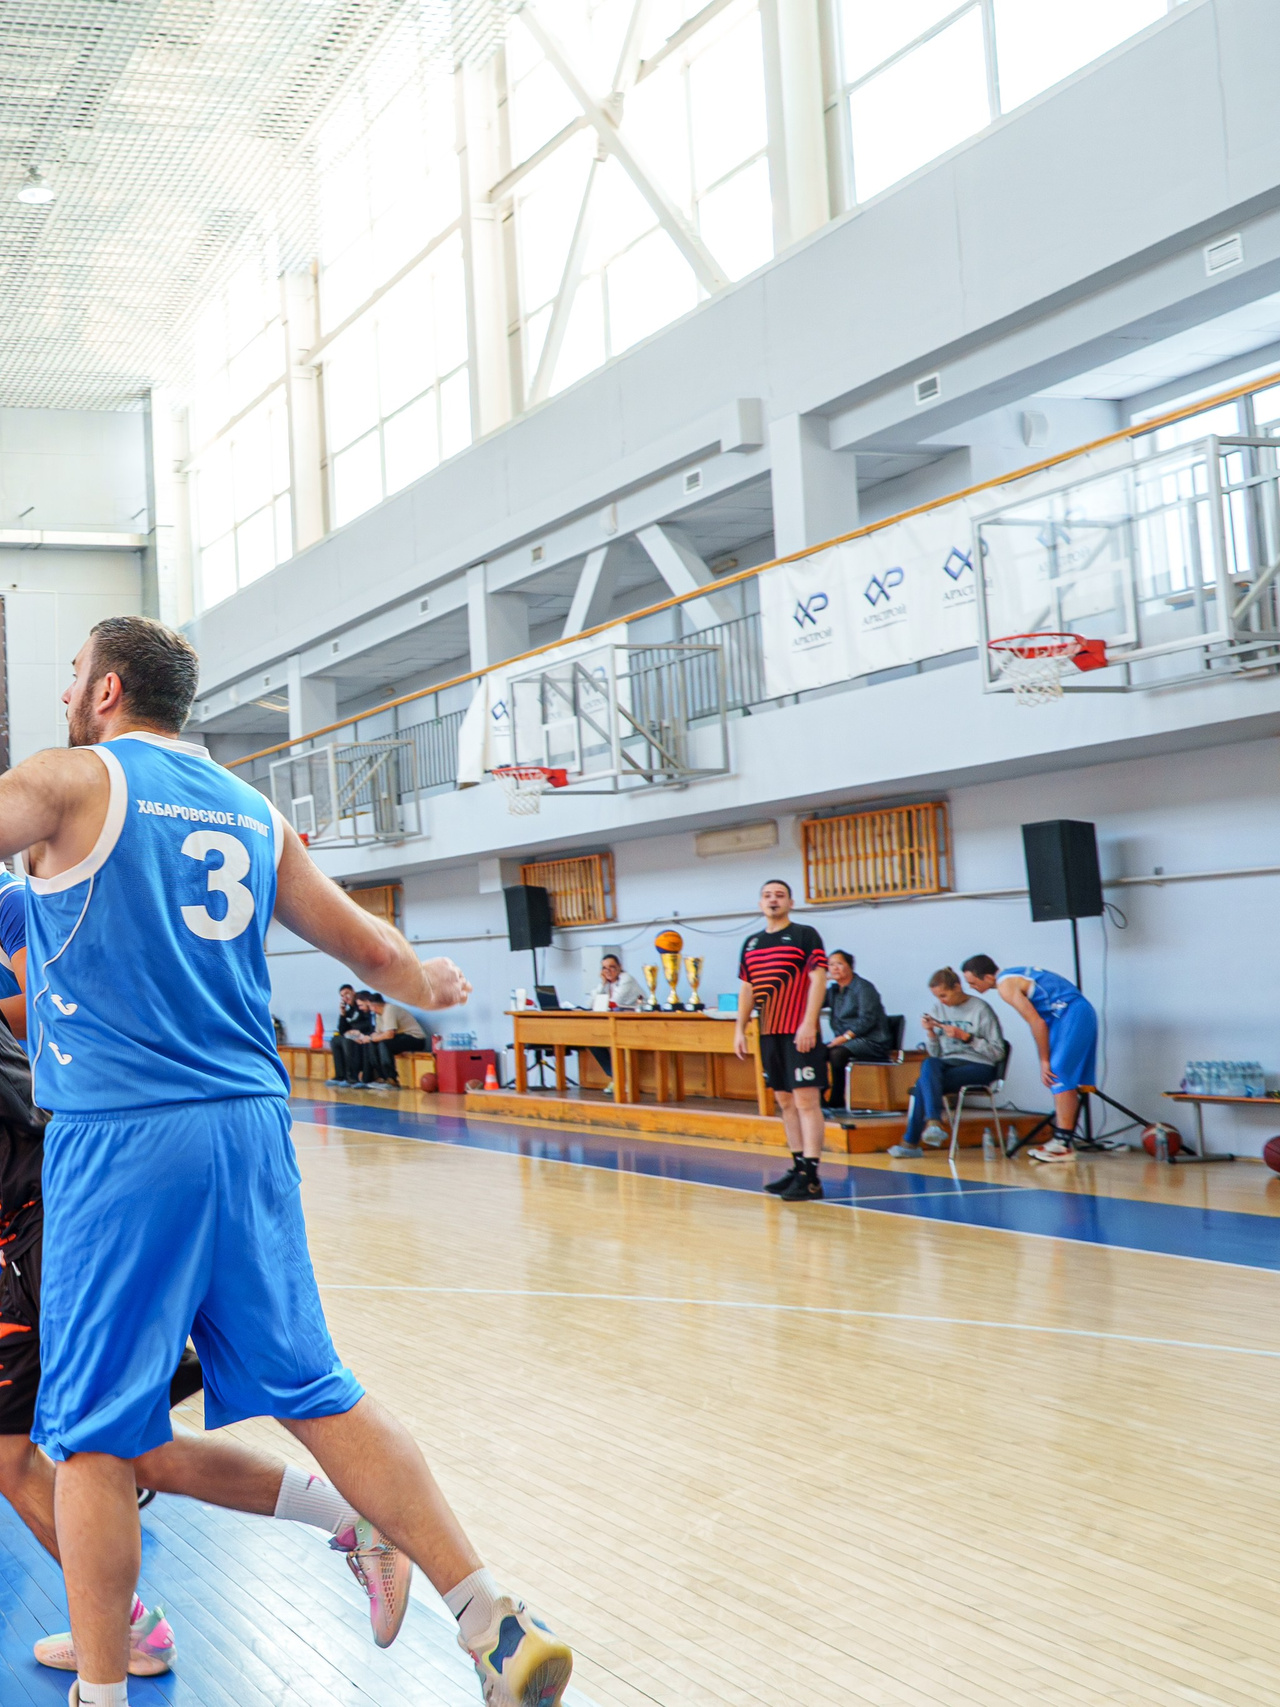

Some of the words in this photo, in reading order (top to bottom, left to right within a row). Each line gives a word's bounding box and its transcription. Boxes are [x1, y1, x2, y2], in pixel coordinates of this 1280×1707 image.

[136, 799, 237, 827] ХАБАРОВСКОЕ
[179, 829, 256, 941] 3
[794, 1065, 816, 1082] 16
